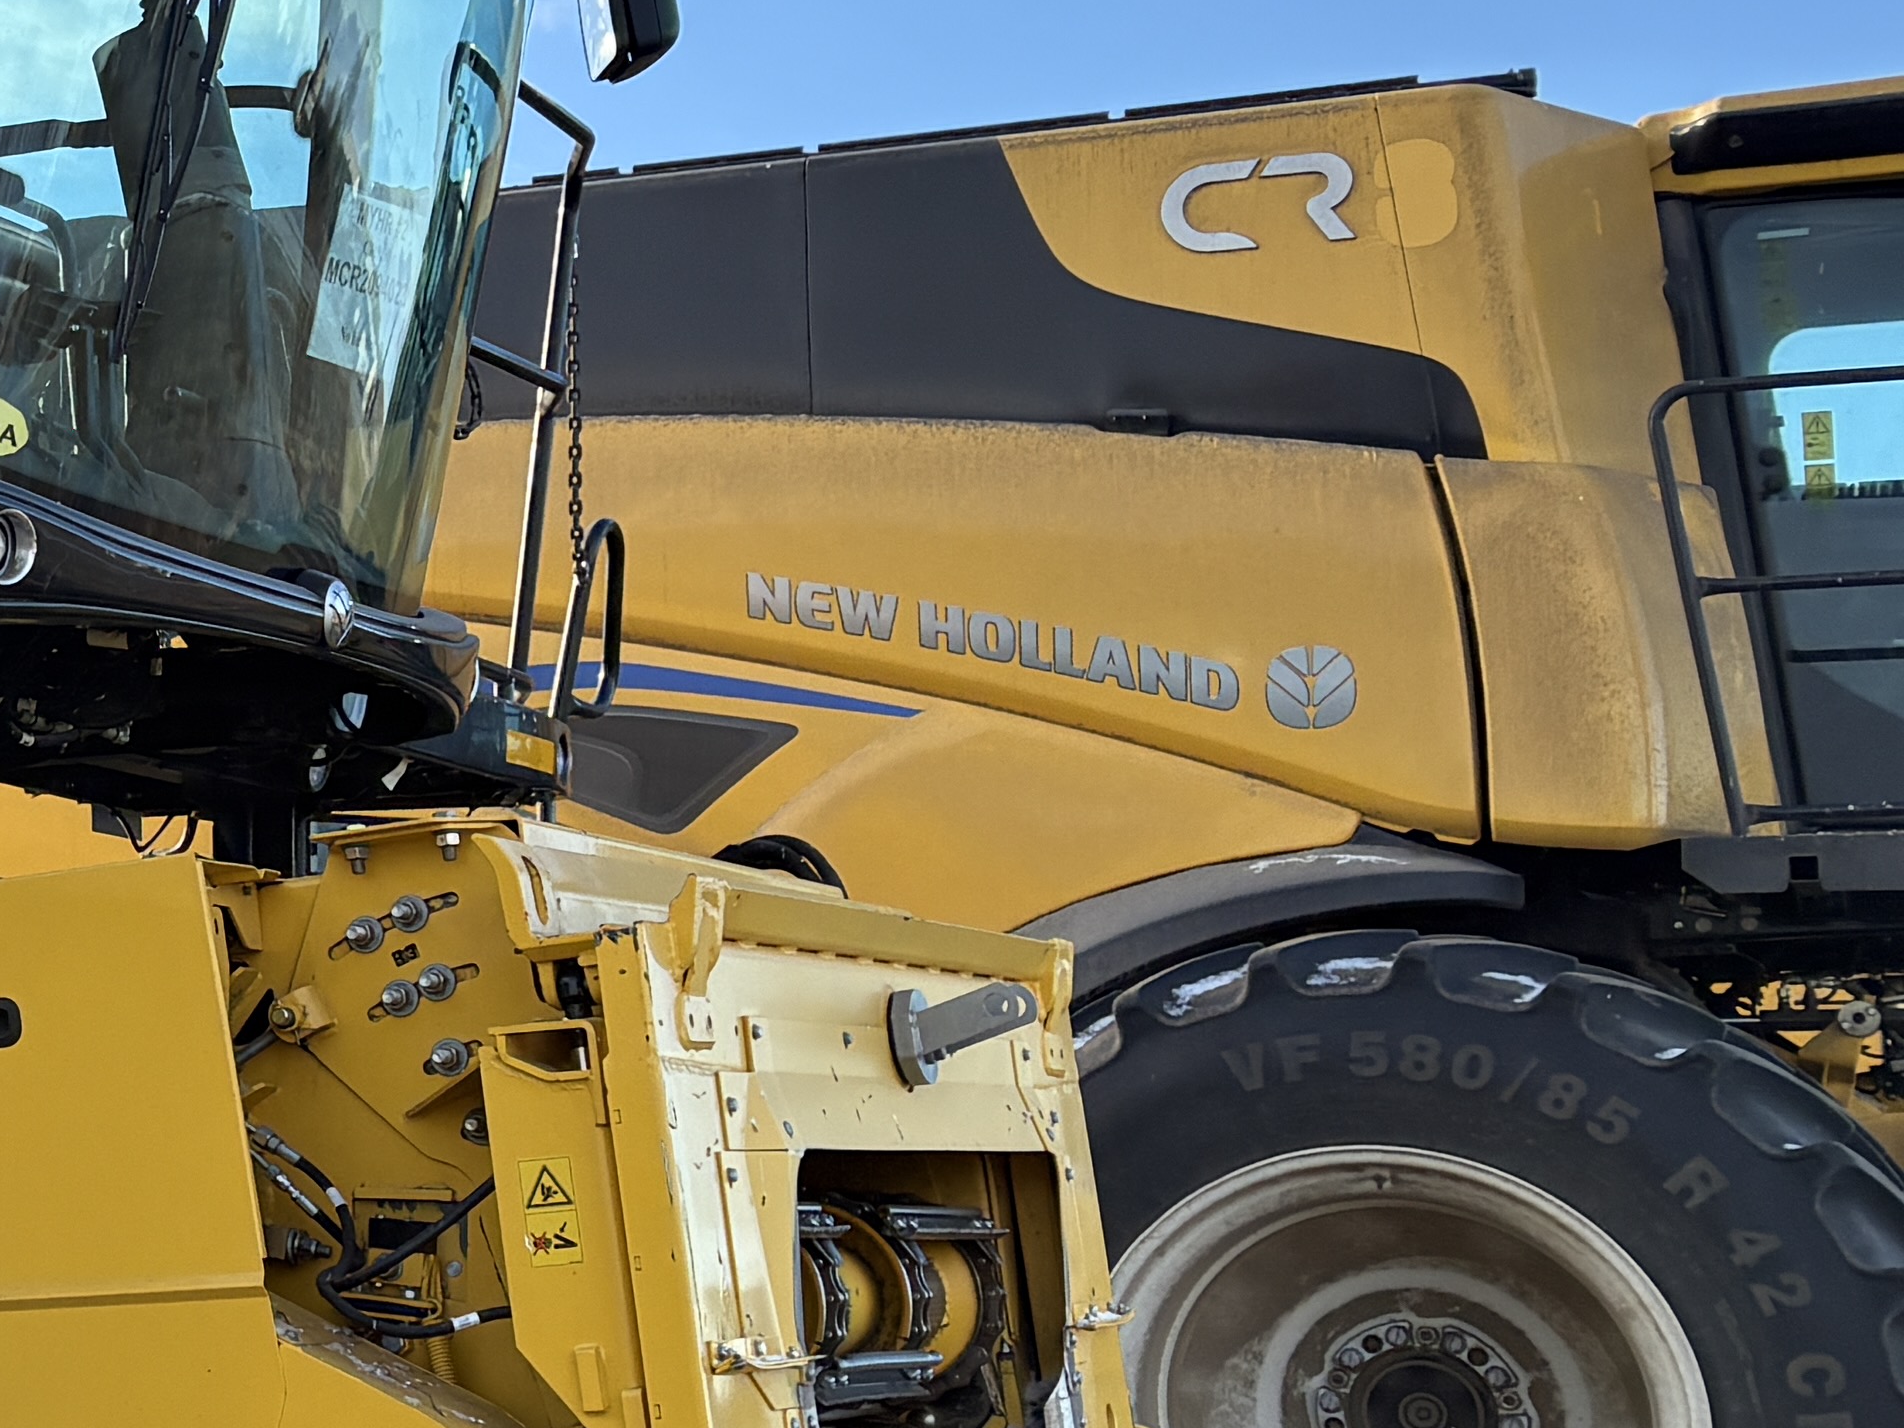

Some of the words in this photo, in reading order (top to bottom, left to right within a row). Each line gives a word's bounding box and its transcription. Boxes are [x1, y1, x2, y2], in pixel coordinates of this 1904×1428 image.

[1160, 152, 1356, 253] CR
[746, 571, 898, 641] NEW
[918, 600, 1240, 712] HOLLAND
[1222, 1032, 1321, 1093] VF
[1346, 1029, 1642, 1146] 580/85
[1662, 1154, 1730, 1210] R
[1725, 1228, 1813, 1318] 42
